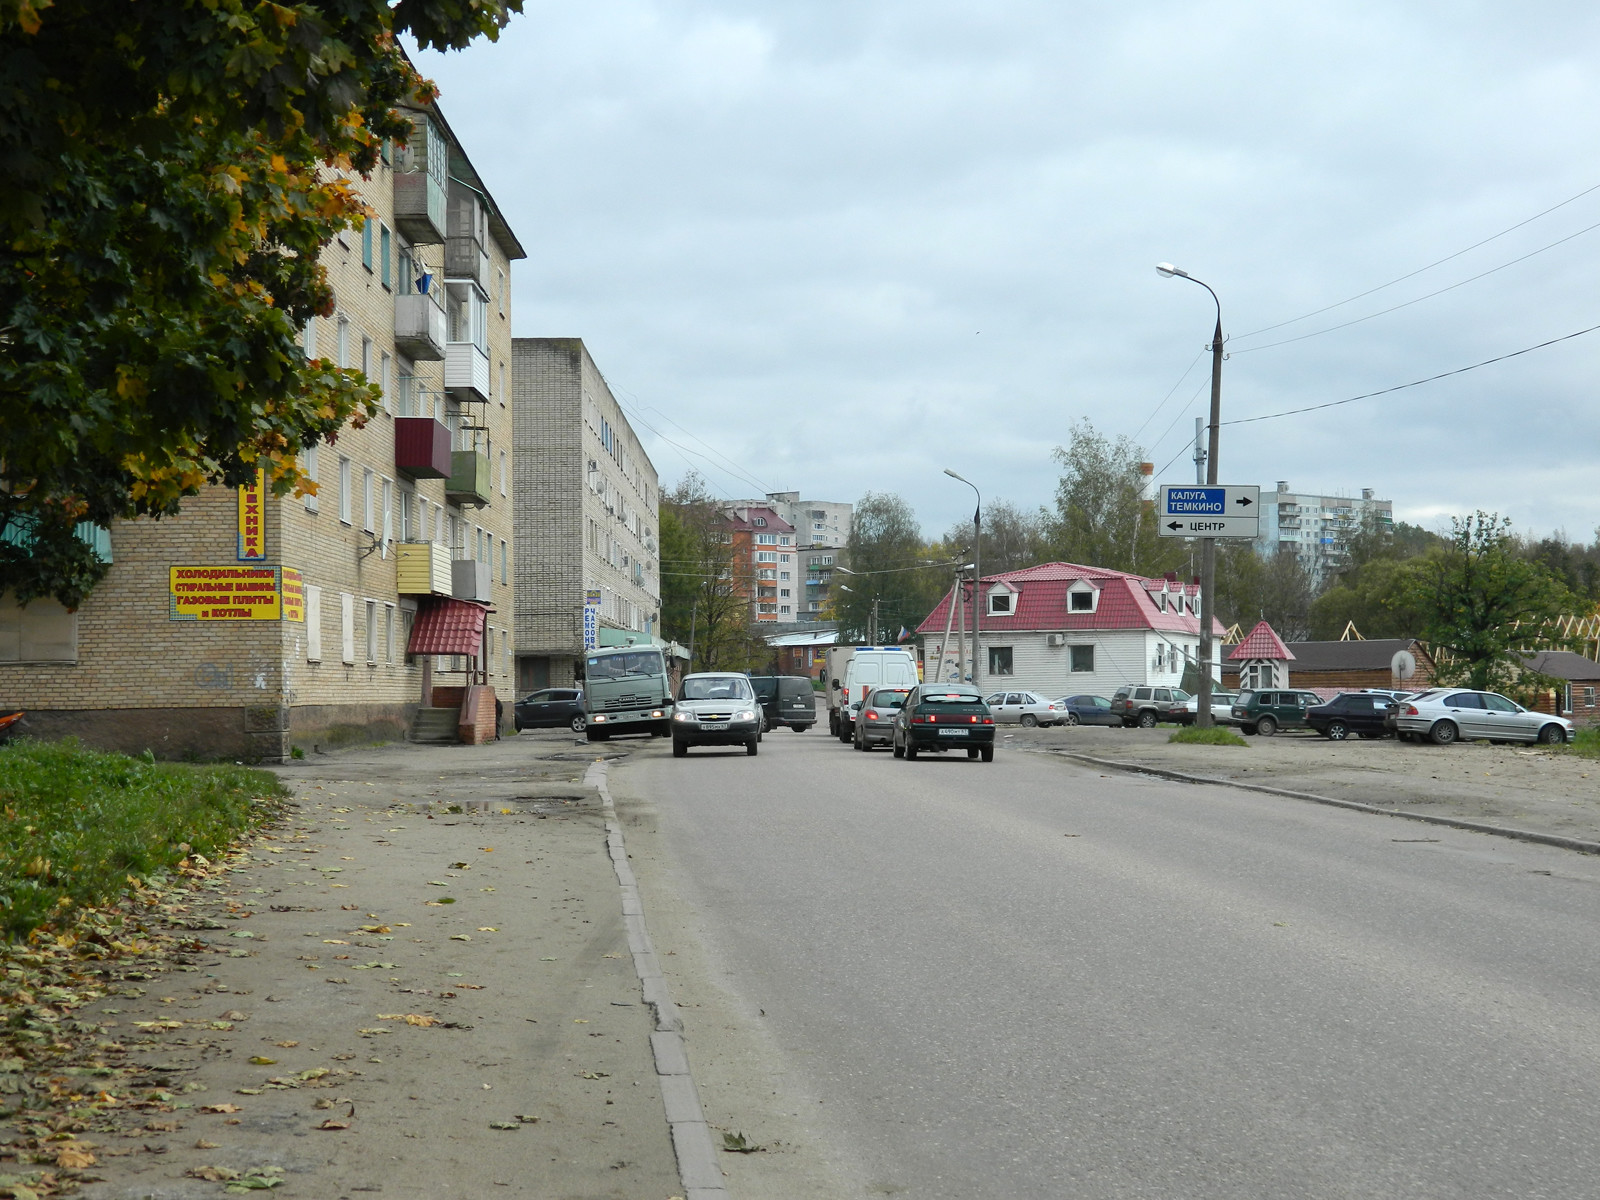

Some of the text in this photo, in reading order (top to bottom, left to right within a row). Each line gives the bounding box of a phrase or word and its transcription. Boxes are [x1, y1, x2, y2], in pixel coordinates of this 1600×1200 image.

[1171, 491, 1207, 500] КАЛУГА
[1170, 502, 1222, 511] ТЕМКИНО
[1190, 522, 1225, 532] ЦЕНТР
[176, 569, 275, 580] ХОЛОДИЛЬНИКИ
[175, 582, 233, 592] СТИРАЛЬНЫЕ
[235, 582, 276, 592] МАШИНЫ
[176, 595, 230, 605] ГАЗОВЫЕ
[233, 595, 274, 605] ПЛИТЫ
[212, 608, 252, 618] КОТЛЫ
